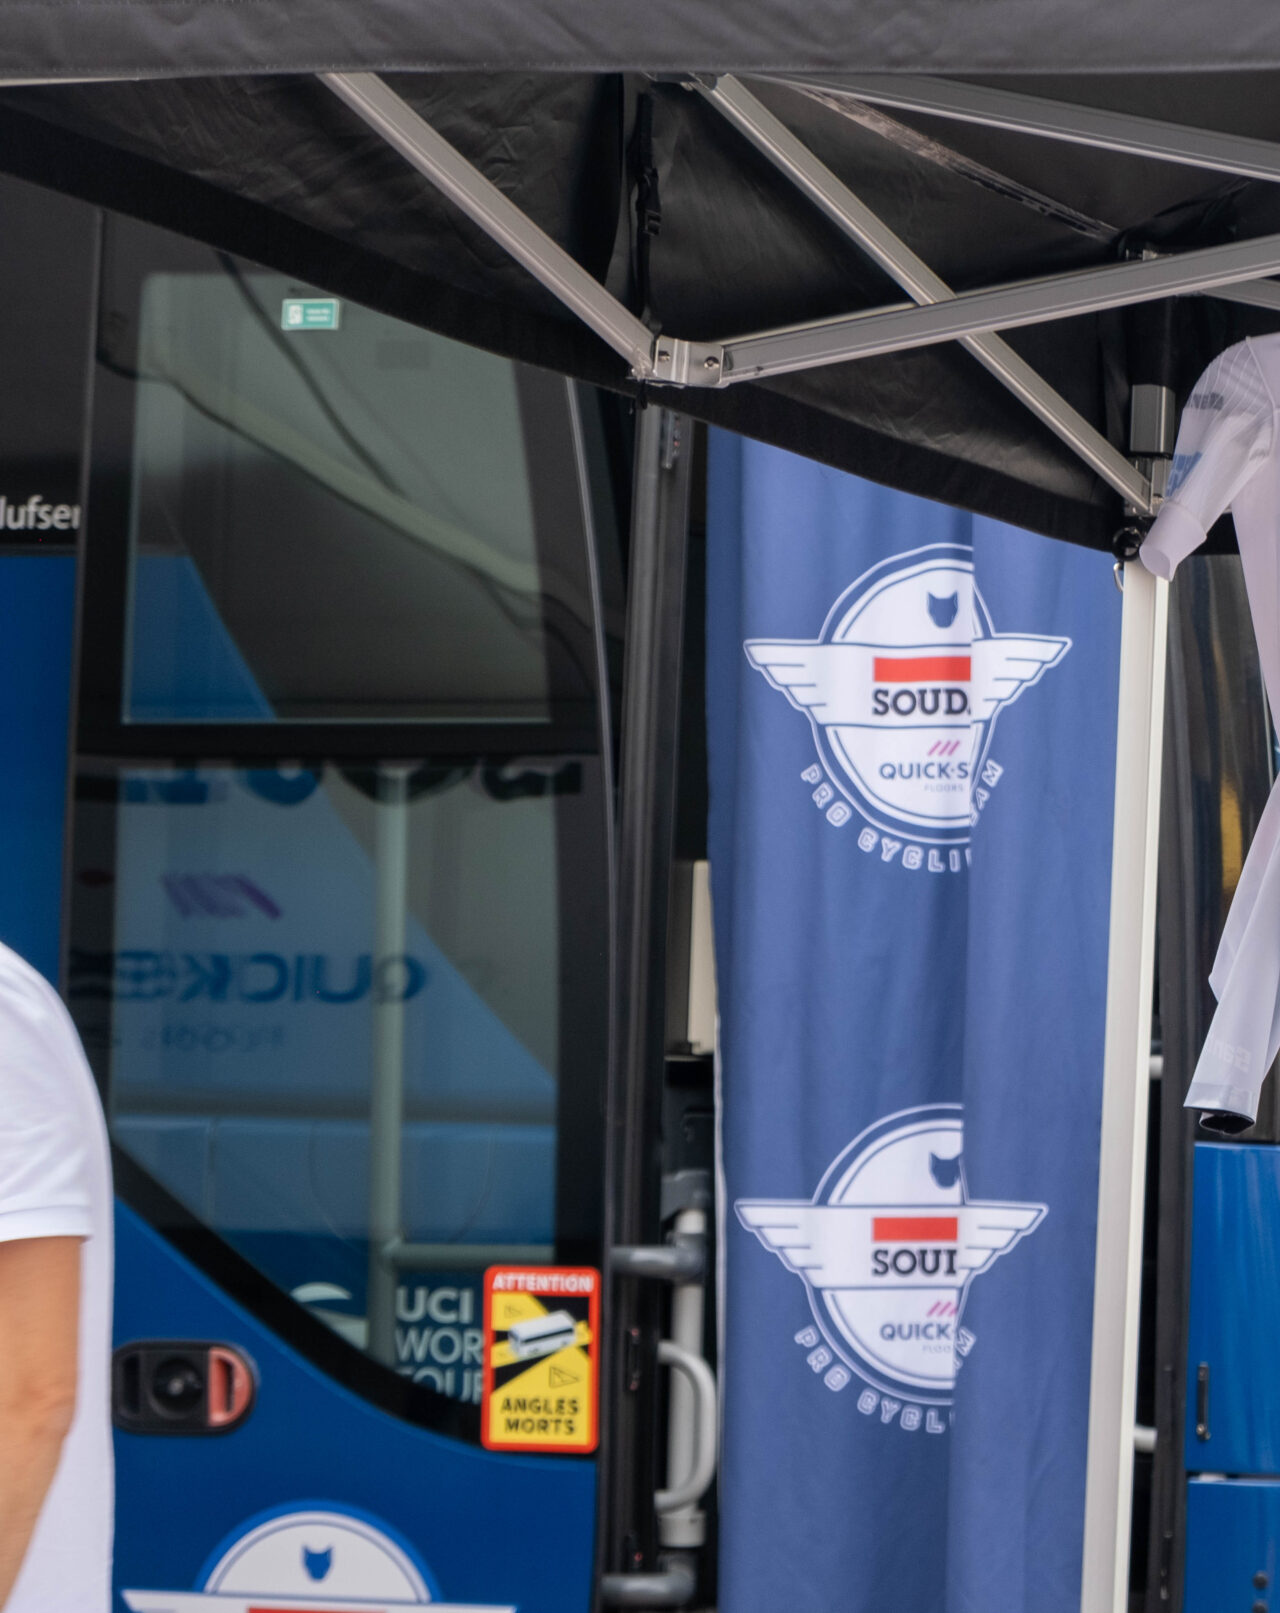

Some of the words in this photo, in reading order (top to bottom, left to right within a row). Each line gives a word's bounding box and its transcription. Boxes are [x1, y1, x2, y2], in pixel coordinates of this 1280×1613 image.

[872, 688, 970, 716] SOUD
[493, 1272, 594, 1293] ATTENTION
[396, 1286, 473, 1324] UCI
[501, 1397, 581, 1416] ANGLES
[505, 1417, 576, 1437] MORTS
